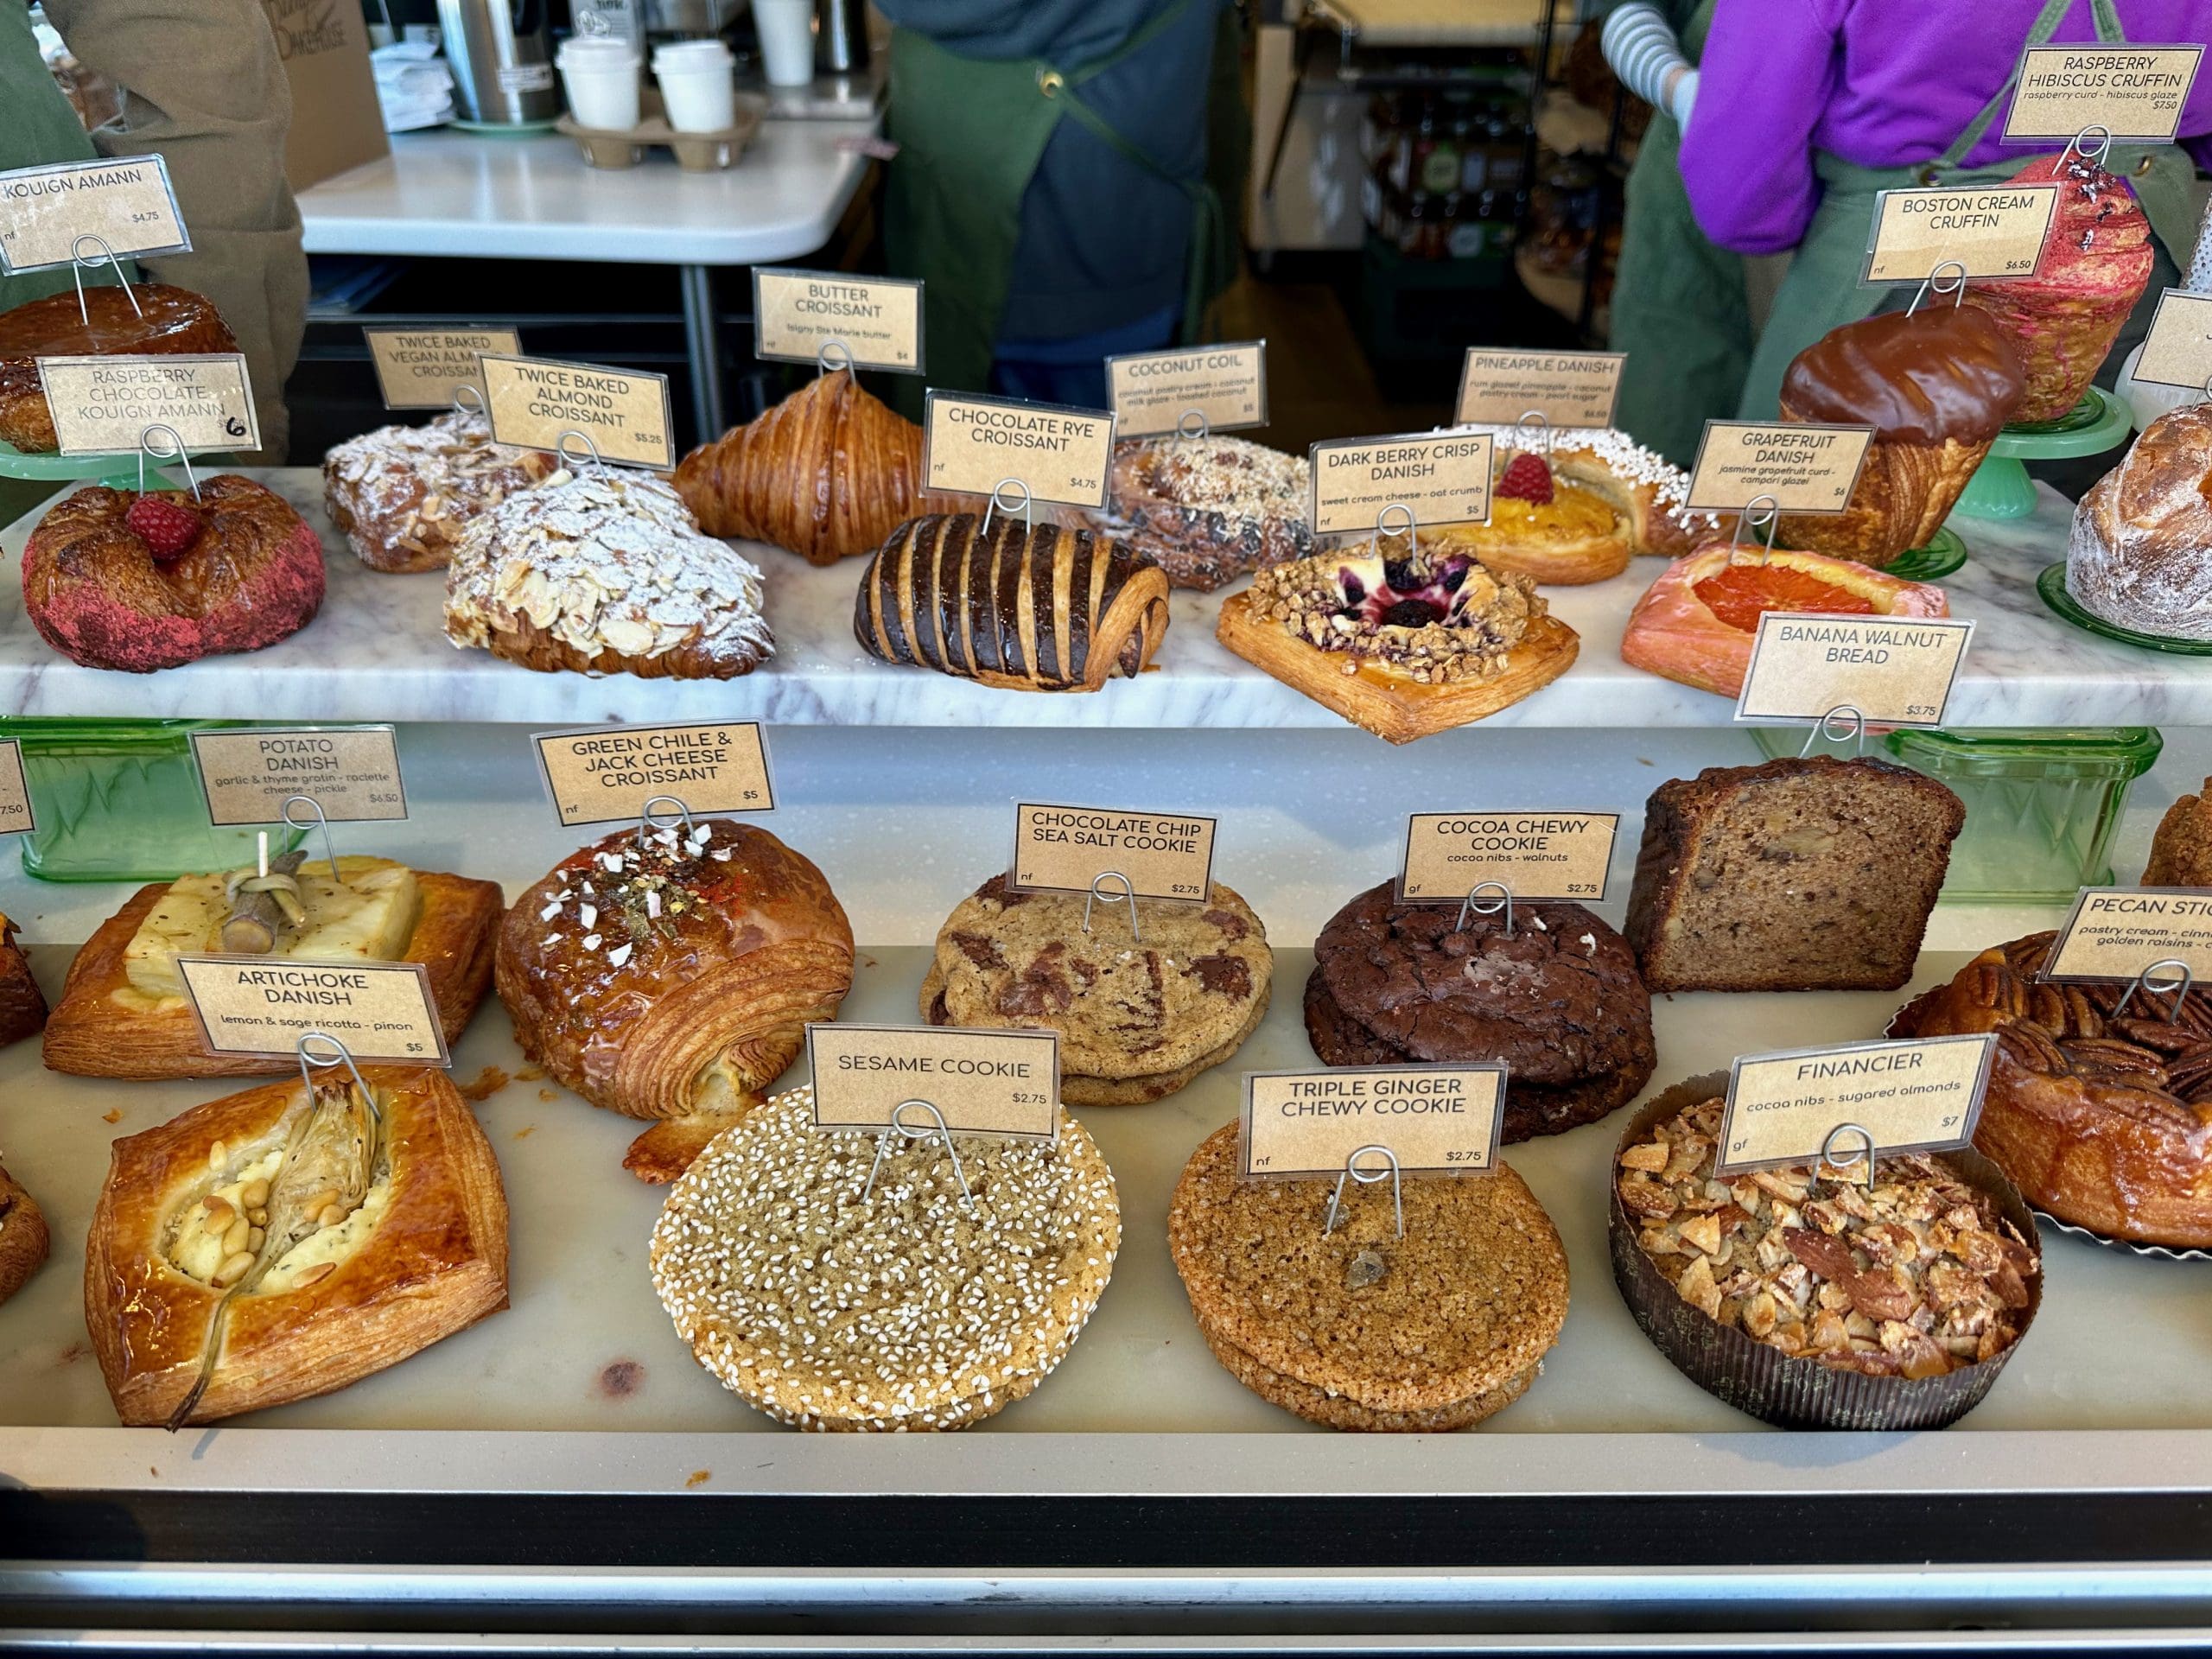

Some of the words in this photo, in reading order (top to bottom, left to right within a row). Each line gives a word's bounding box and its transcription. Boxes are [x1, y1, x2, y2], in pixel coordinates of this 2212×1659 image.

[2064, 57, 2158, 70] RASPBERRY
[2028, 74, 2107, 86] HIBISCUS
[2112, 74, 2183, 86] CRUFFIN
[2024, 92, 2073, 100] raspberry
[2151, 92, 2177, 100] glaze
[3, 178, 73, 199] KOUIGN
[79, 169, 142, 189] AMANN
[1903, 198, 1973, 213] BOSTON
[1978, 196, 2034, 209] CREAM
[132, 212, 159, 223] $4.75
[1930, 214, 1999, 229] CRUFFIN
[4, 232, 16, 240] nf
[810, 284, 868, 302] BUTTER
[796, 300, 881, 318] CROISSANT
[396, 336, 440, 348] TWICE
[445, 337, 491, 348] BAKED
[390, 352, 440, 363] VEGAN
[413, 366, 477, 378] CROISSA
[1128, 359, 1203, 377] COCONUT
[1208, 354, 1243, 369] COIL
[1476, 357, 1554, 372] PINEAPPLE
[1558, 360, 1615, 373] DANISH
[92, 369, 195, 384] RASPBERRY
[515, 367, 569, 386] TWICE
[575, 375, 630, 395] BAKED
[90, 385, 208, 402] CHOCOLATE
[537, 388, 613, 409] ALMOND
[78, 405, 152, 420] KOUIGN
[158, 404, 226, 417] AMANN
[529, 404, 625, 427] CROISSANT
[226, 416, 247, 436] 6
[950, 408, 1058, 434] CHOCOLATE
[1064, 422, 1095, 437] RYE
[635, 433, 663, 444] $5.25
[972, 429, 1070, 452] CROISSANT
[1742, 433, 1836, 448] GRAPEFRUIT
[1329, 452, 1371, 467] DARK
[1376, 448, 1428, 464] BERRY
[1433, 443, 1480, 459] CRISP
[1755, 450, 1815, 464] DANISH
[1371, 464, 1435, 480] DANISH
[1718, 466, 1756, 474] jasmine
[1758, 467, 1806, 476] grapefruit
[1070, 478, 1096, 489] $4.75
[1352, 495, 1382, 504] cream
[1386, 492, 1421, 501] cheese
[1450, 486, 1482, 496] crumb
[1834, 487, 1845, 496] $6
[1467, 505, 1479, 514] $5
[1780, 626, 1859, 644] BANANA
[1866, 630, 1948, 648] WALNUT
[1826, 647, 1889, 664] BREAD
[1906, 705, 1936, 715] $3.75
[260, 740, 333, 753] POTATO
[572, 738, 643, 755] GREEN
[649, 733, 713, 749] CHILE
[718, 732, 733, 745] &
[266, 757, 339, 771] DANISH
[586, 755, 639, 772] JACK
[643, 749, 728, 767] CHEESE
[216, 778, 248, 787] garlic
[264, 775, 298, 785] thyme
[302, 773, 336, 785] gratin
[346, 772, 390, 782] raclette
[601, 766, 718, 788] CROISSANT
[264, 785, 302, 794] cheese
[315, 785, 347, 794] pickle
[743, 790, 759, 800] $5
[370, 794, 398, 804] $6.50
[566, 804, 580, 814] nf
[1033, 812, 1151, 834] CHOCOLATE
[1156, 823, 1201, 837] CHIP
[1437, 821, 1510, 834] COCOA
[1516, 821, 1590, 834] CHEWY
[1033, 829, 1069, 842] SEA
[1074, 832, 1119, 847] SALT
[1123, 836, 1197, 853] COOKIE
[1471, 837, 1548, 850] COOKIE
[1522, 853, 1568, 861] walnuts
[1172, 884, 1200, 894] $2.75
[1409, 884, 1421, 894] gf
[1567, 884, 1597, 893] $2.75
[2090, 899, 2167, 913] PECAN
[2078, 925, 2124, 935] pastry
[2181, 929, 2212, 938] cinn
[2096, 937, 2147, 946] golden
[2148, 938, 2193, 948] raisins
[238, 971, 369, 989] ARTICHOKE
[264, 988, 353, 1006] DANISH
[221, 1014, 264, 1026] lemon
[266, 1016, 276, 1026] &
[280, 1019, 312, 1029] sage
[315, 1018, 362, 1029] ricotta
[374, 1020, 413, 1032] pinon
[407, 1042, 423, 1052] $5
[838, 1055, 933, 1072] SESAME
[941, 1059, 1031, 1078] COOKIE
[1797, 1052, 1923, 1081] FINANCIER
[1289, 1080, 1366, 1097] TRIPLE
[1374, 1079, 1462, 1095] GINGER
[1013, 1092, 1047, 1104] $2.75
[1746, 1099, 1791, 1112] cocoa
[1795, 1096, 1826, 1107] nibs
[1838, 1086, 1897, 1103] sugared
[1900, 1081, 1961, 1096] almonds
[1281, 1100, 1368, 1116] CHEWY
[1375, 1097, 1467, 1115] COOKIE
[1942, 1116, 1959, 1127] $7
[1733, 1139, 1748, 1152] gf
[1256, 1156, 1271, 1166] nf
[1446, 1151, 1482, 1161] $2.75
